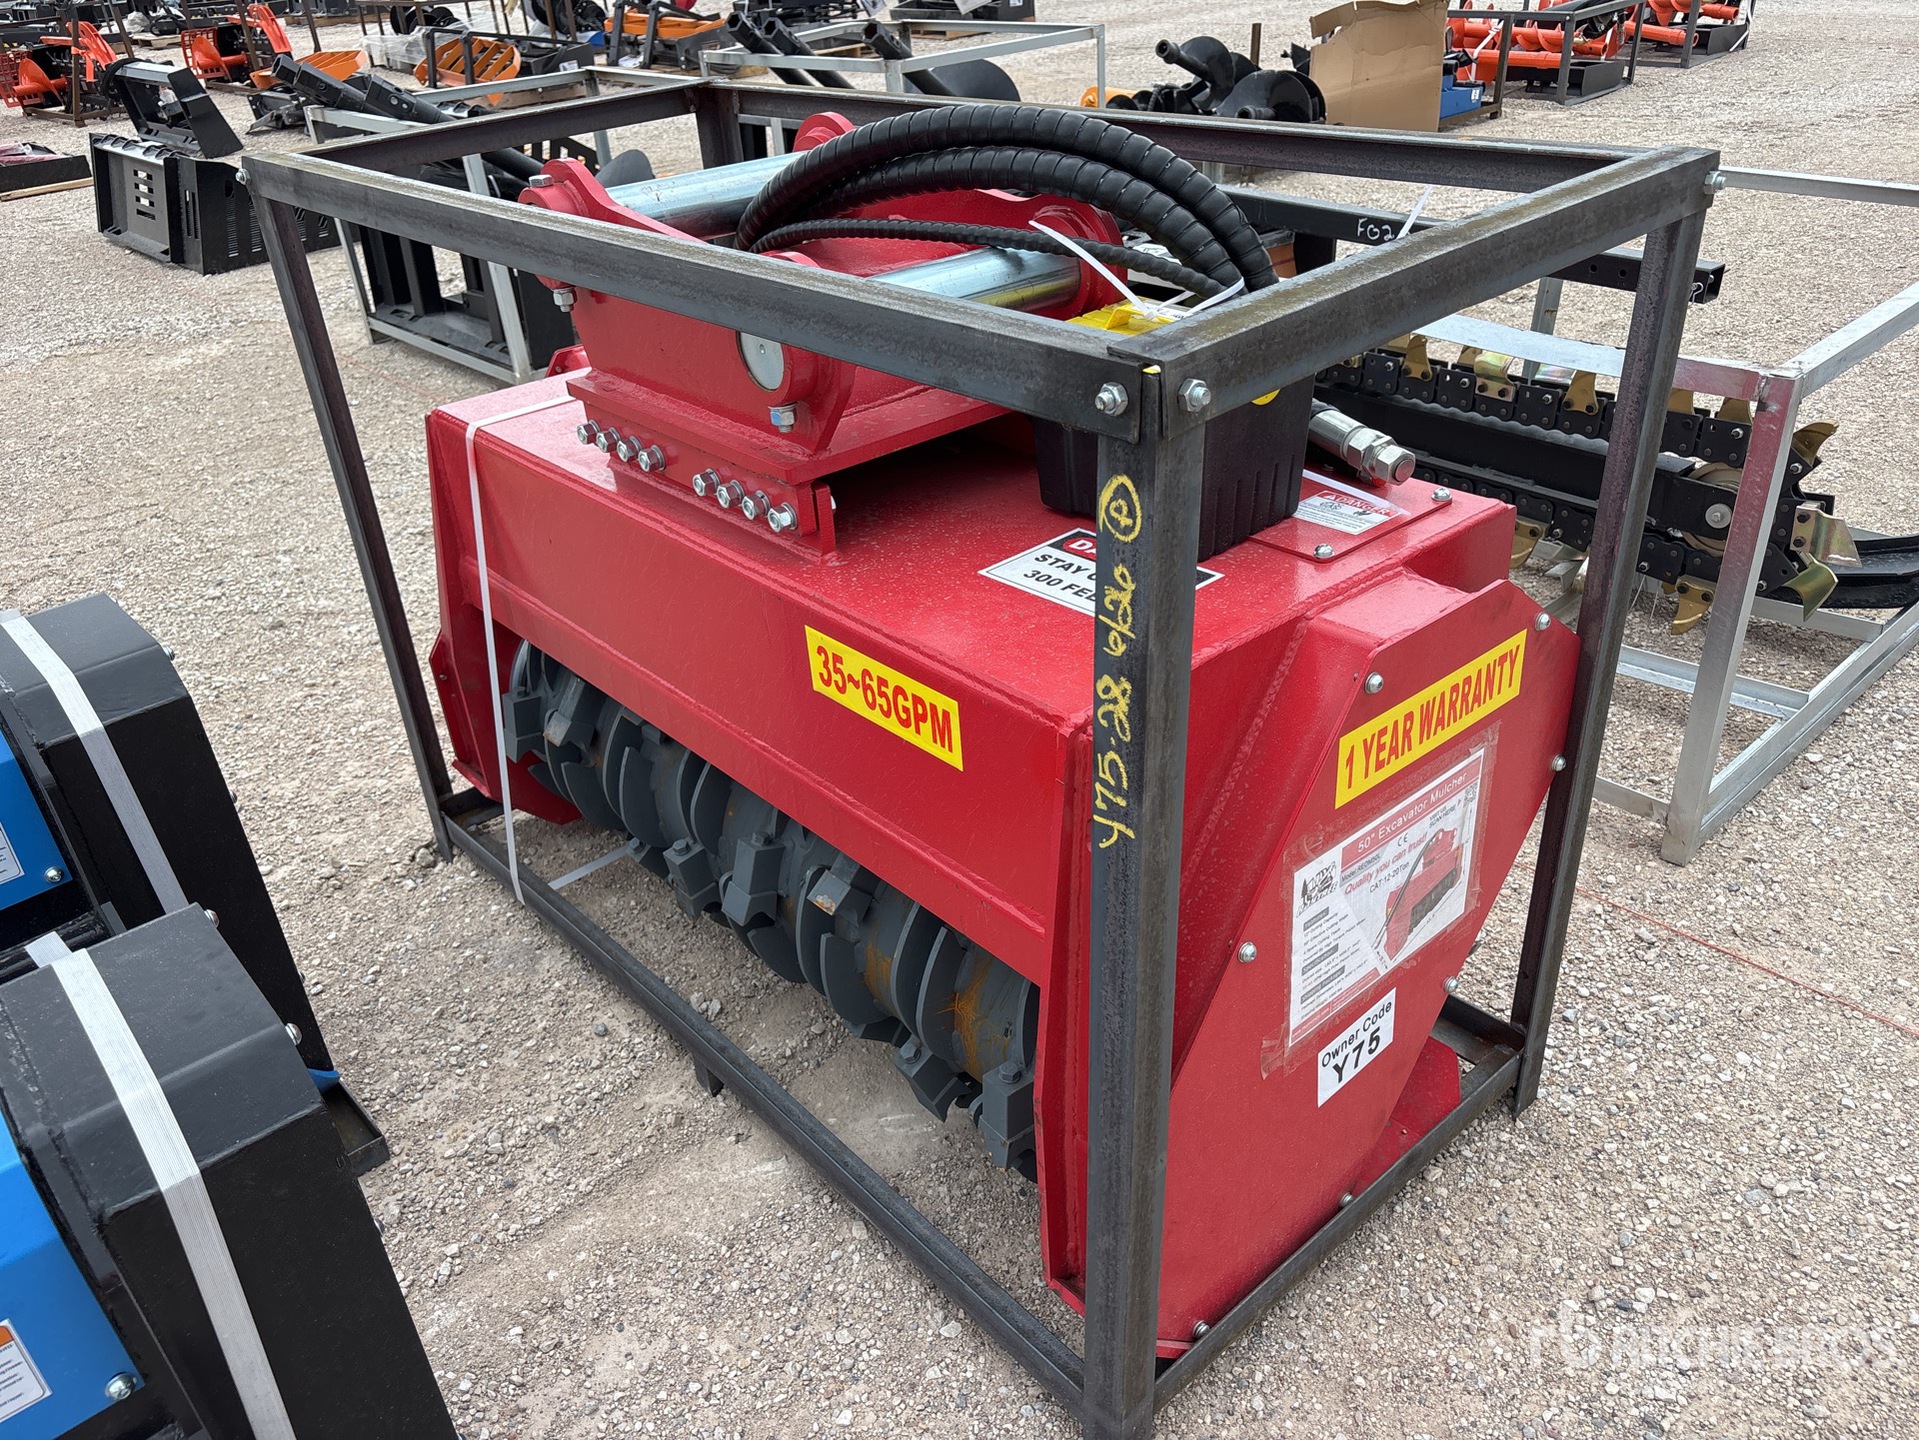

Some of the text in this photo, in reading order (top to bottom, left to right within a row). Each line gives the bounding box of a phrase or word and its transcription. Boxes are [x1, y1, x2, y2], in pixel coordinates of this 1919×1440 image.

[1023, 570, 1063, 586] 300
[1034, 554, 1091, 574] STAY
[817, 645, 954, 754] 35~65GPM
[1345, 644, 1521, 790] 1 YEAR WARRANTY
[1357, 772, 1467, 853] 50" Excavator Mulcher
[1345, 870, 1375, 895] Quality
[1374, 859, 1391, 880] you
[1392, 848, 1406, 865] can
[1322, 1028, 1360, 1068] Owner
[1363, 1002, 1392, 1033] Code
[1332, 1025, 1381, 1084] Y75
